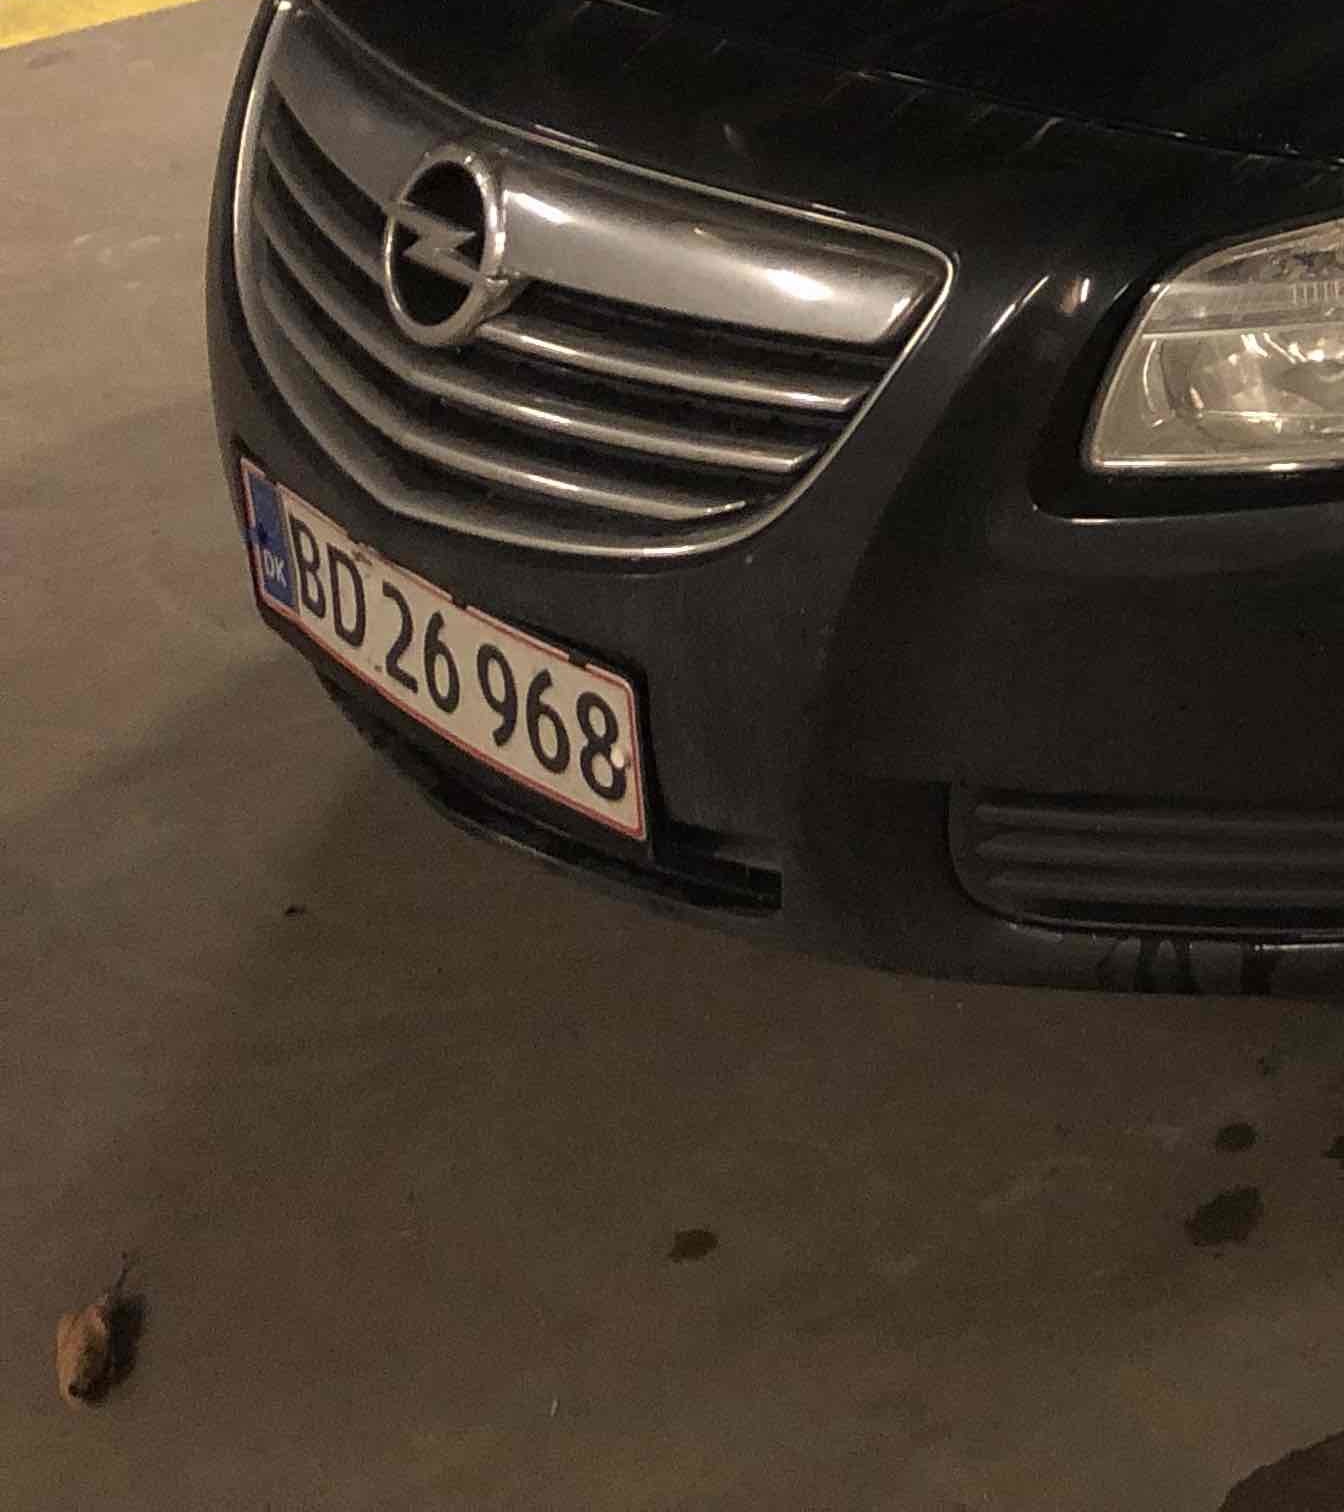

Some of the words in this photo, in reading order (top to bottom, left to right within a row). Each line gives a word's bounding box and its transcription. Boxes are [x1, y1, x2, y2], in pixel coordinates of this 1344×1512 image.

[263, 549, 287, 588] DK
[289, 513, 366, 648] BD
[382, 581, 461, 715] 26
[476, 643, 627, 803] 968
